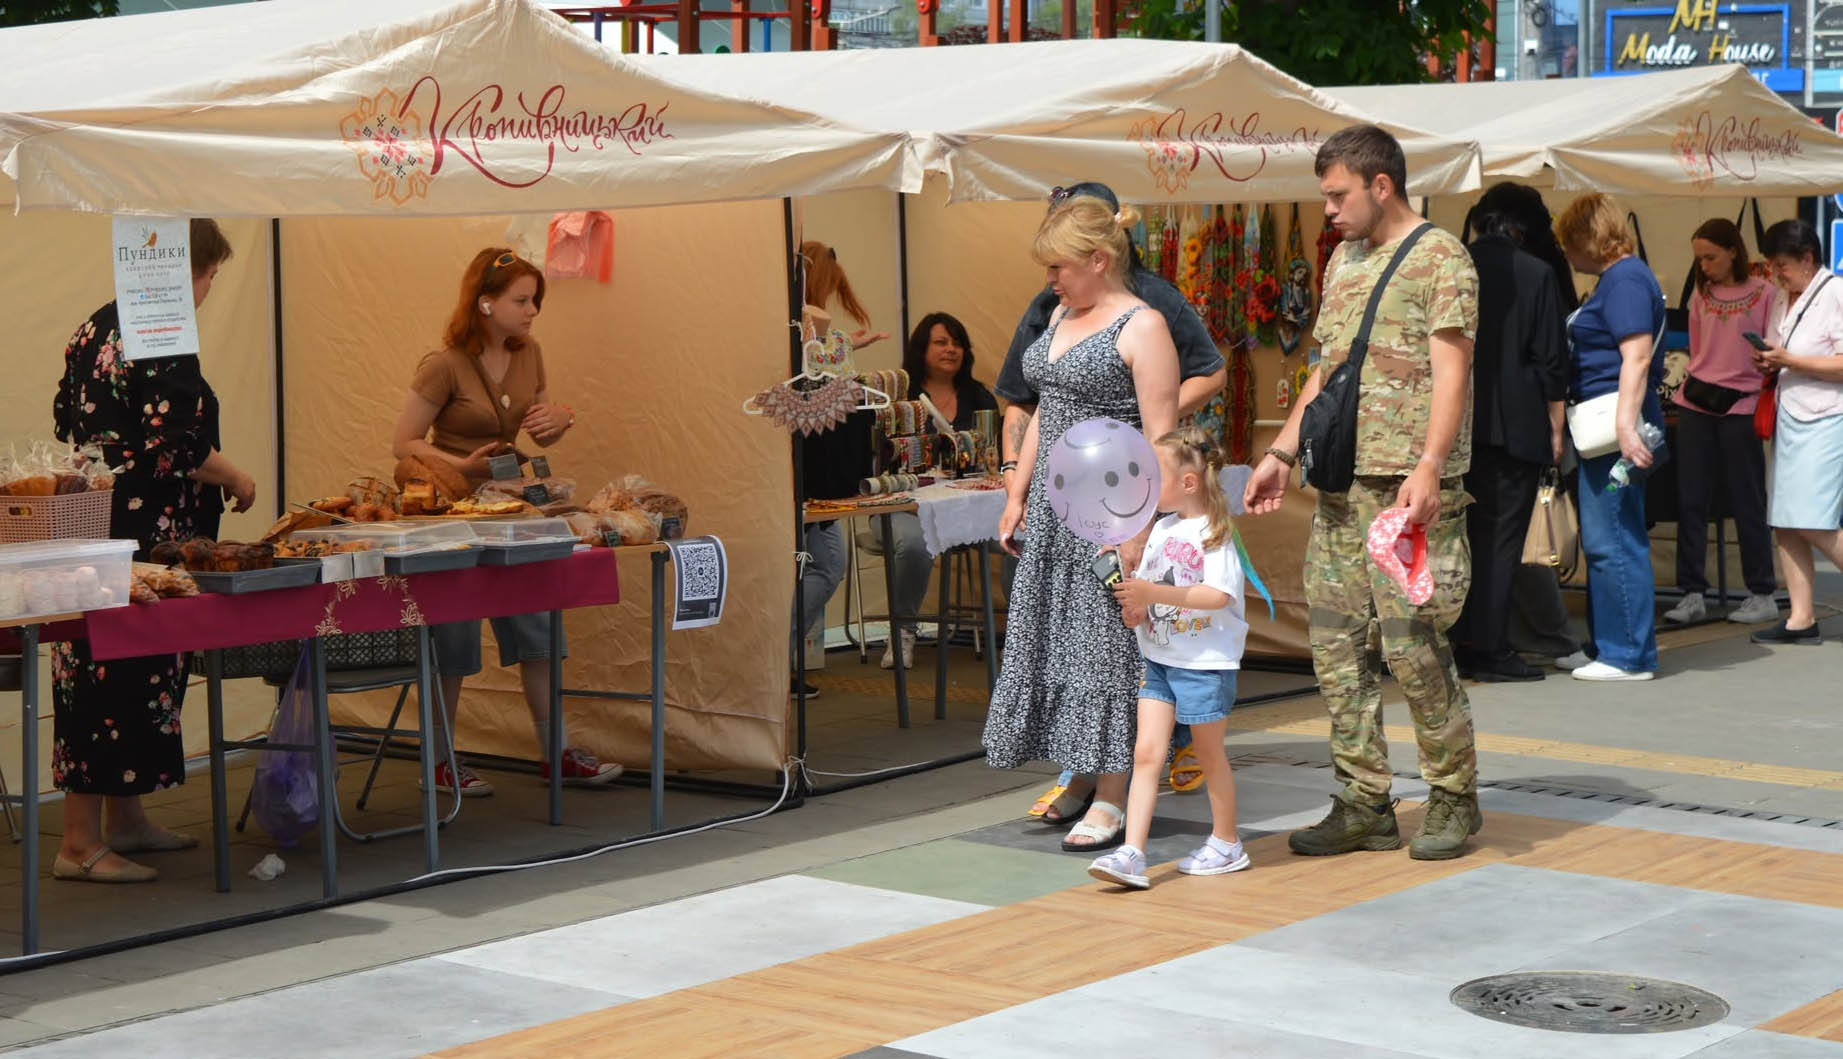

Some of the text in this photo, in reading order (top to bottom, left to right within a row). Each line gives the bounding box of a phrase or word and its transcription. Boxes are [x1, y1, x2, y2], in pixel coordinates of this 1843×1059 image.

[1668, 0, 1717, 33] MH
[1617, 32, 1776, 65] Moda House
[398, 75, 674, 189] Кропивницький
[118, 246, 186, 265] Пундики
